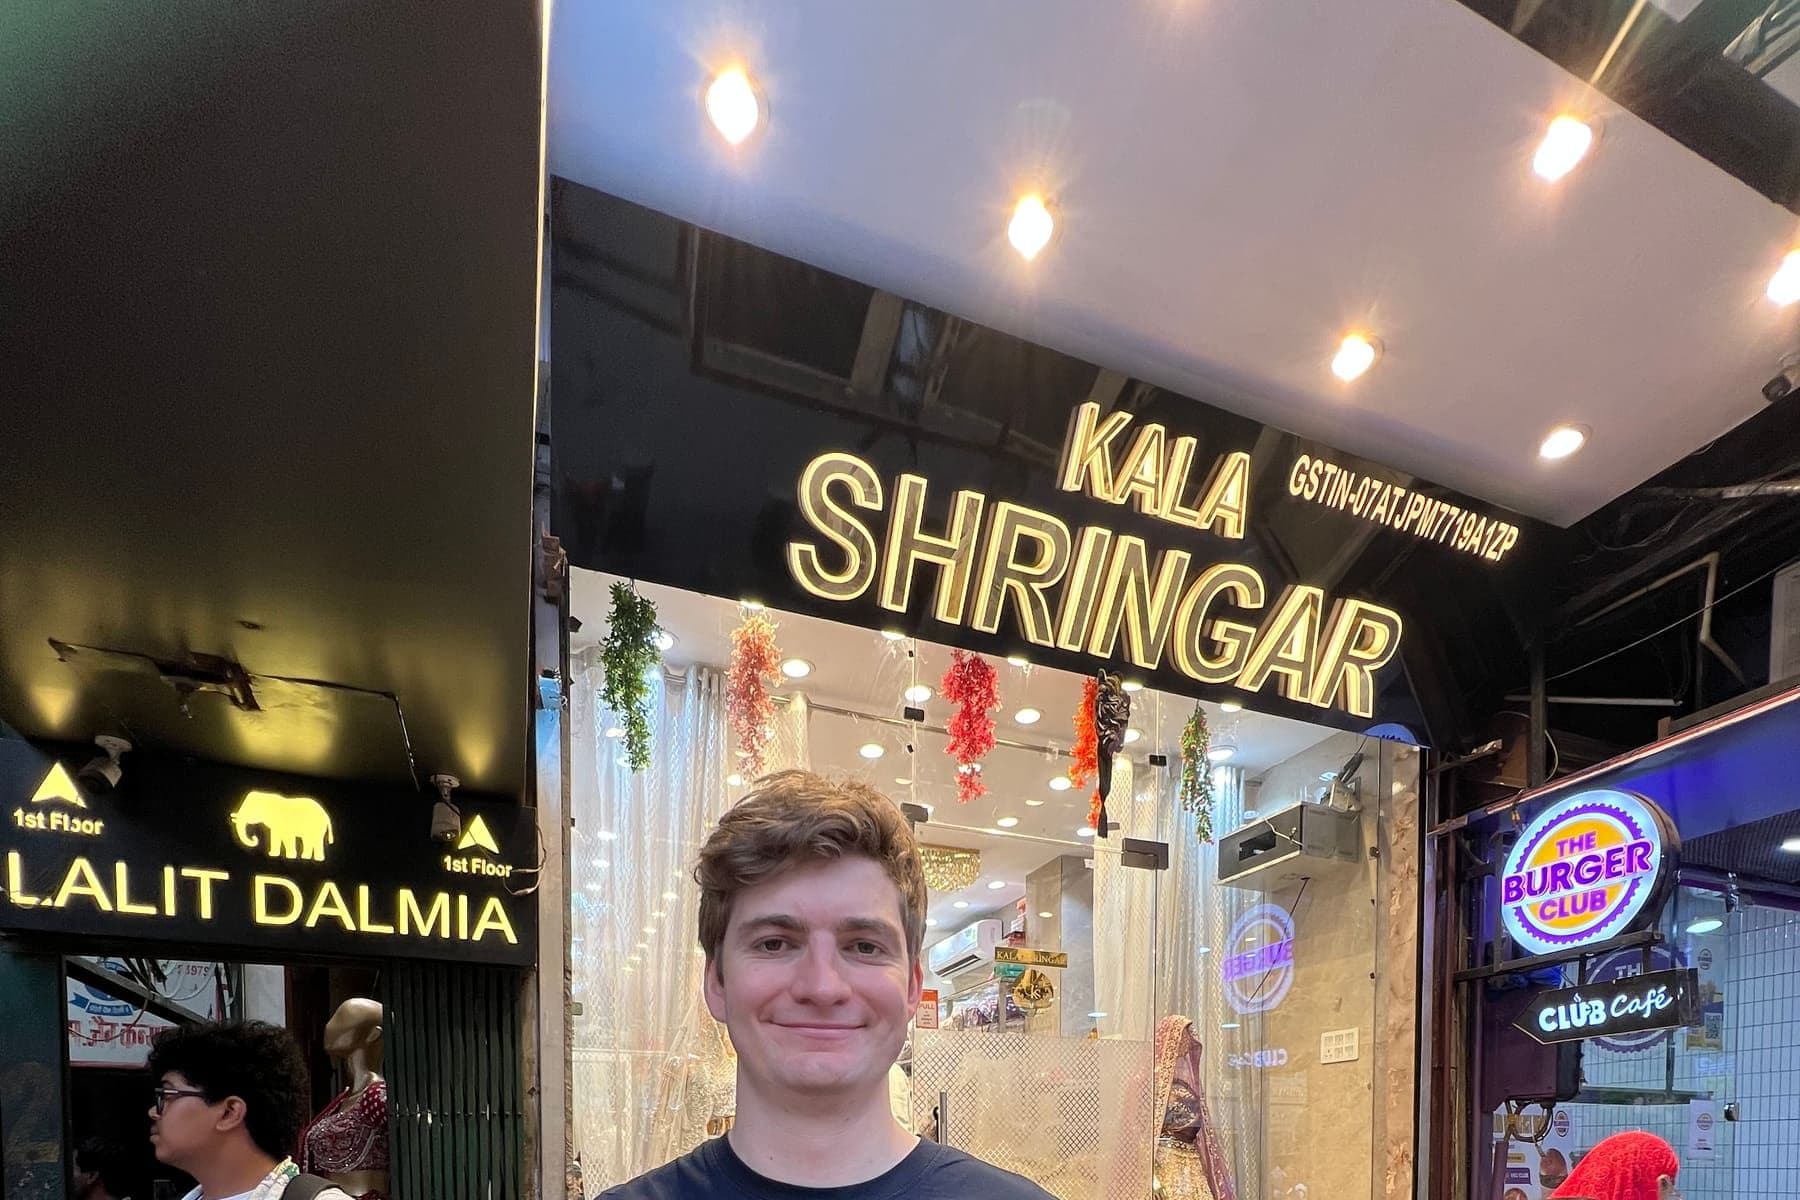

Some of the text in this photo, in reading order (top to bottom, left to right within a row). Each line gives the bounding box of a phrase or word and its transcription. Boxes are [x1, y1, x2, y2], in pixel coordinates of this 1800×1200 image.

[1063, 402, 1251, 539] KALA
[1288, 454, 1520, 562] GSTIN-07ATJPM7719A1ZP
[788, 452, 1403, 718] SHRINGAR
[13, 808, 104, 834] 1st Floor
[1556, 831, 1597, 857] THE
[443, 855, 513, 878] 1st Floor
[1502, 839, 1655, 906] BURGER
[8, 851, 518, 945] LALIT DALMIA
[1538, 888, 1608, 922] CLUB
[1615, 962, 1642, 980] TH
[1538, 985, 1674, 1032] CLUB Café
